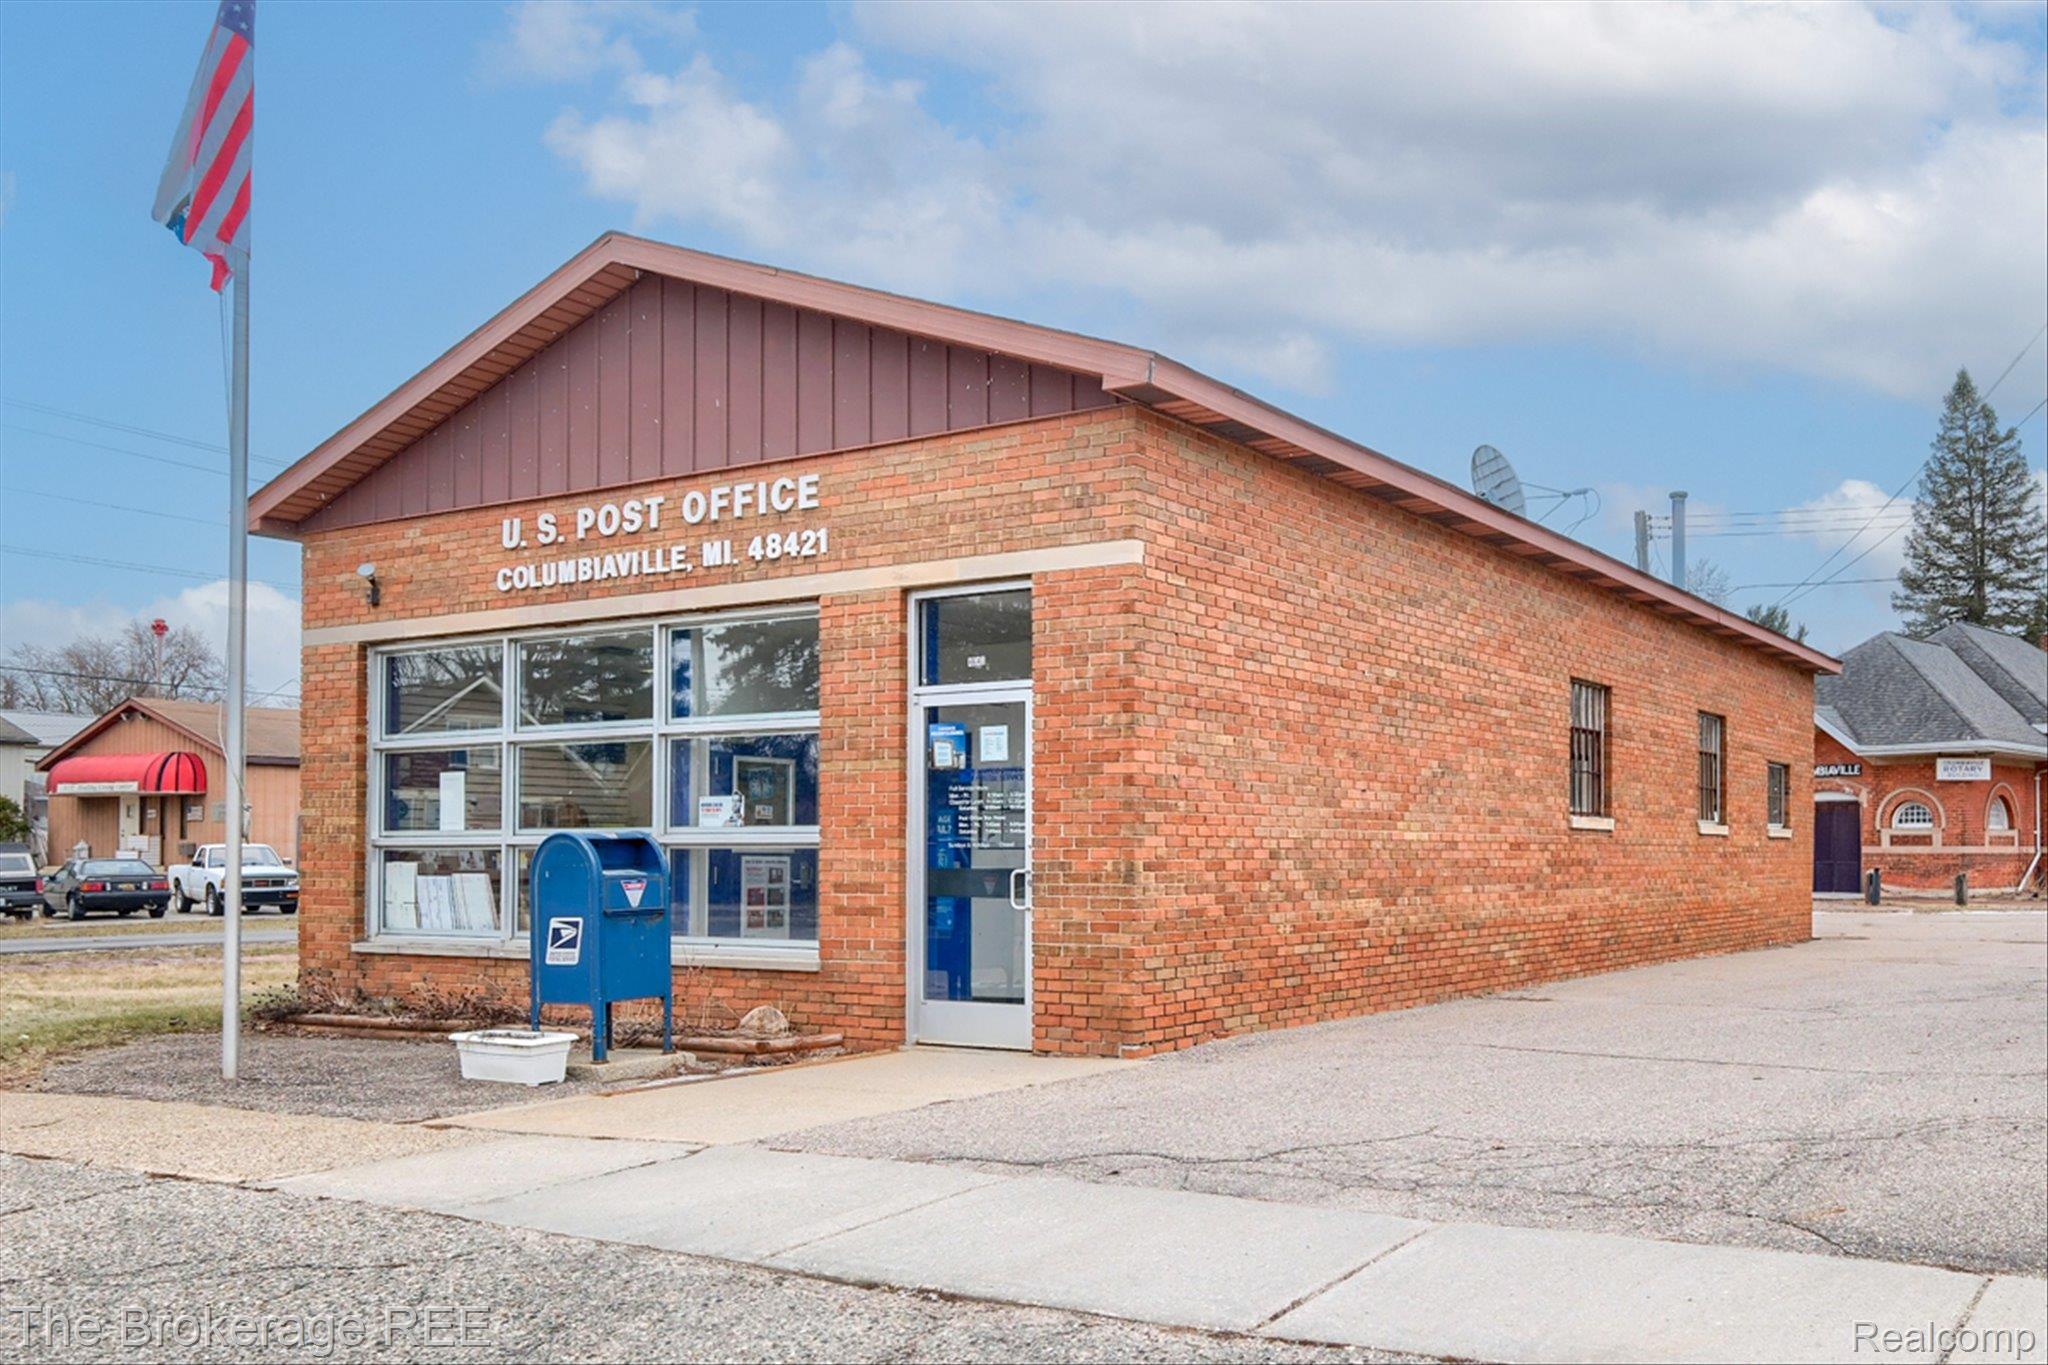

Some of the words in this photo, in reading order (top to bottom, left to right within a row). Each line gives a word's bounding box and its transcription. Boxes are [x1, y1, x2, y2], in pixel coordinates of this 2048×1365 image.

[502, 517, 527, 550] U.
[536, 511, 565, 545] S.
[576, 496, 665, 539] POST
[682, 474, 820, 525] OFFICE
[496, 546, 693, 592] COLUMBIAVILLE,
[701, 539, 739, 567] MI.
[747, 528, 829, 562] 48421
